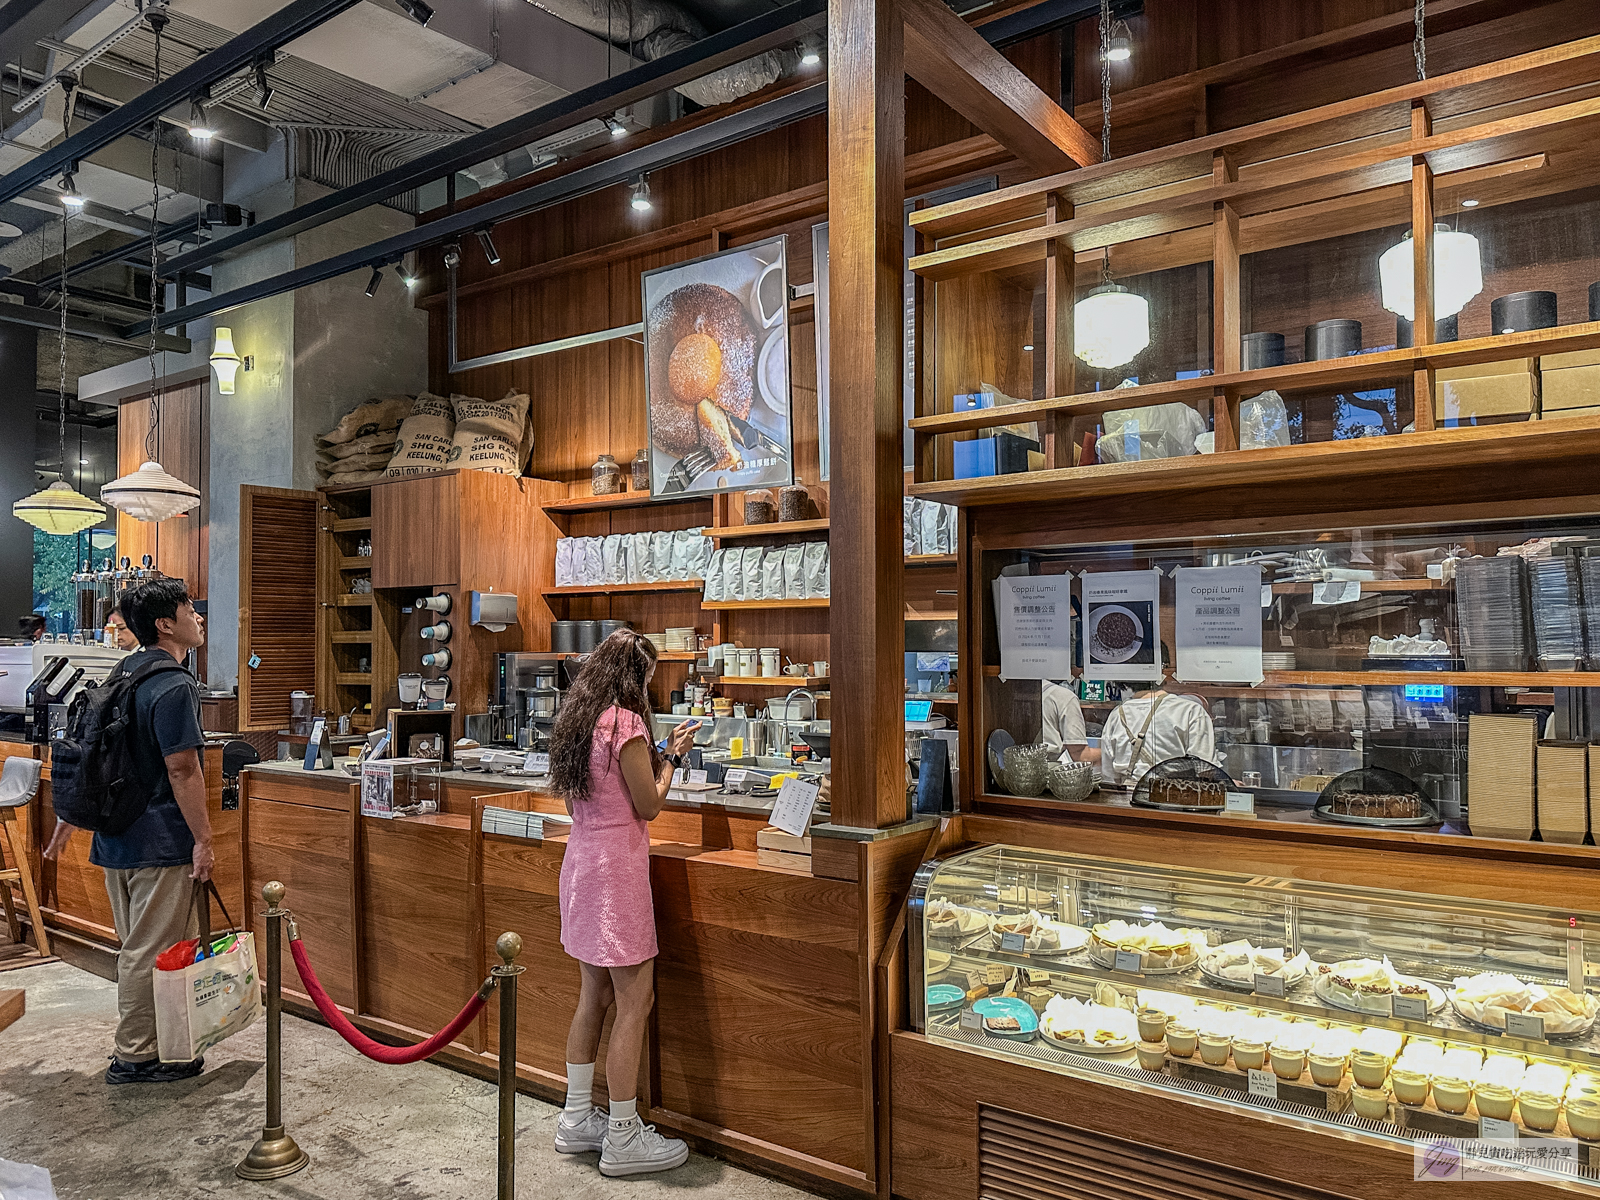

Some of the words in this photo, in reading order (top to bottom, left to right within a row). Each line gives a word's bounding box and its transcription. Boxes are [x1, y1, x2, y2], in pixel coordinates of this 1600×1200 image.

[414, 433, 431, 441] SAN
[473, 435, 490, 444] SAN
[410, 442, 434, 450] SHG
[471, 443, 495, 452] SHG
[406, 452, 443, 464] KEELUNG,
[469, 452, 507, 463] KEELUNG,
[389, 469, 400, 478] 09
[1012, 586, 1035, 594] Coppii
[1190, 586, 1218, 595] Coppii
[1220, 585, 1244, 593] Lumii
[1013, 605, 1056, 614] 售價調整公告
[1195, 606, 1241, 615] 產品調整公告
